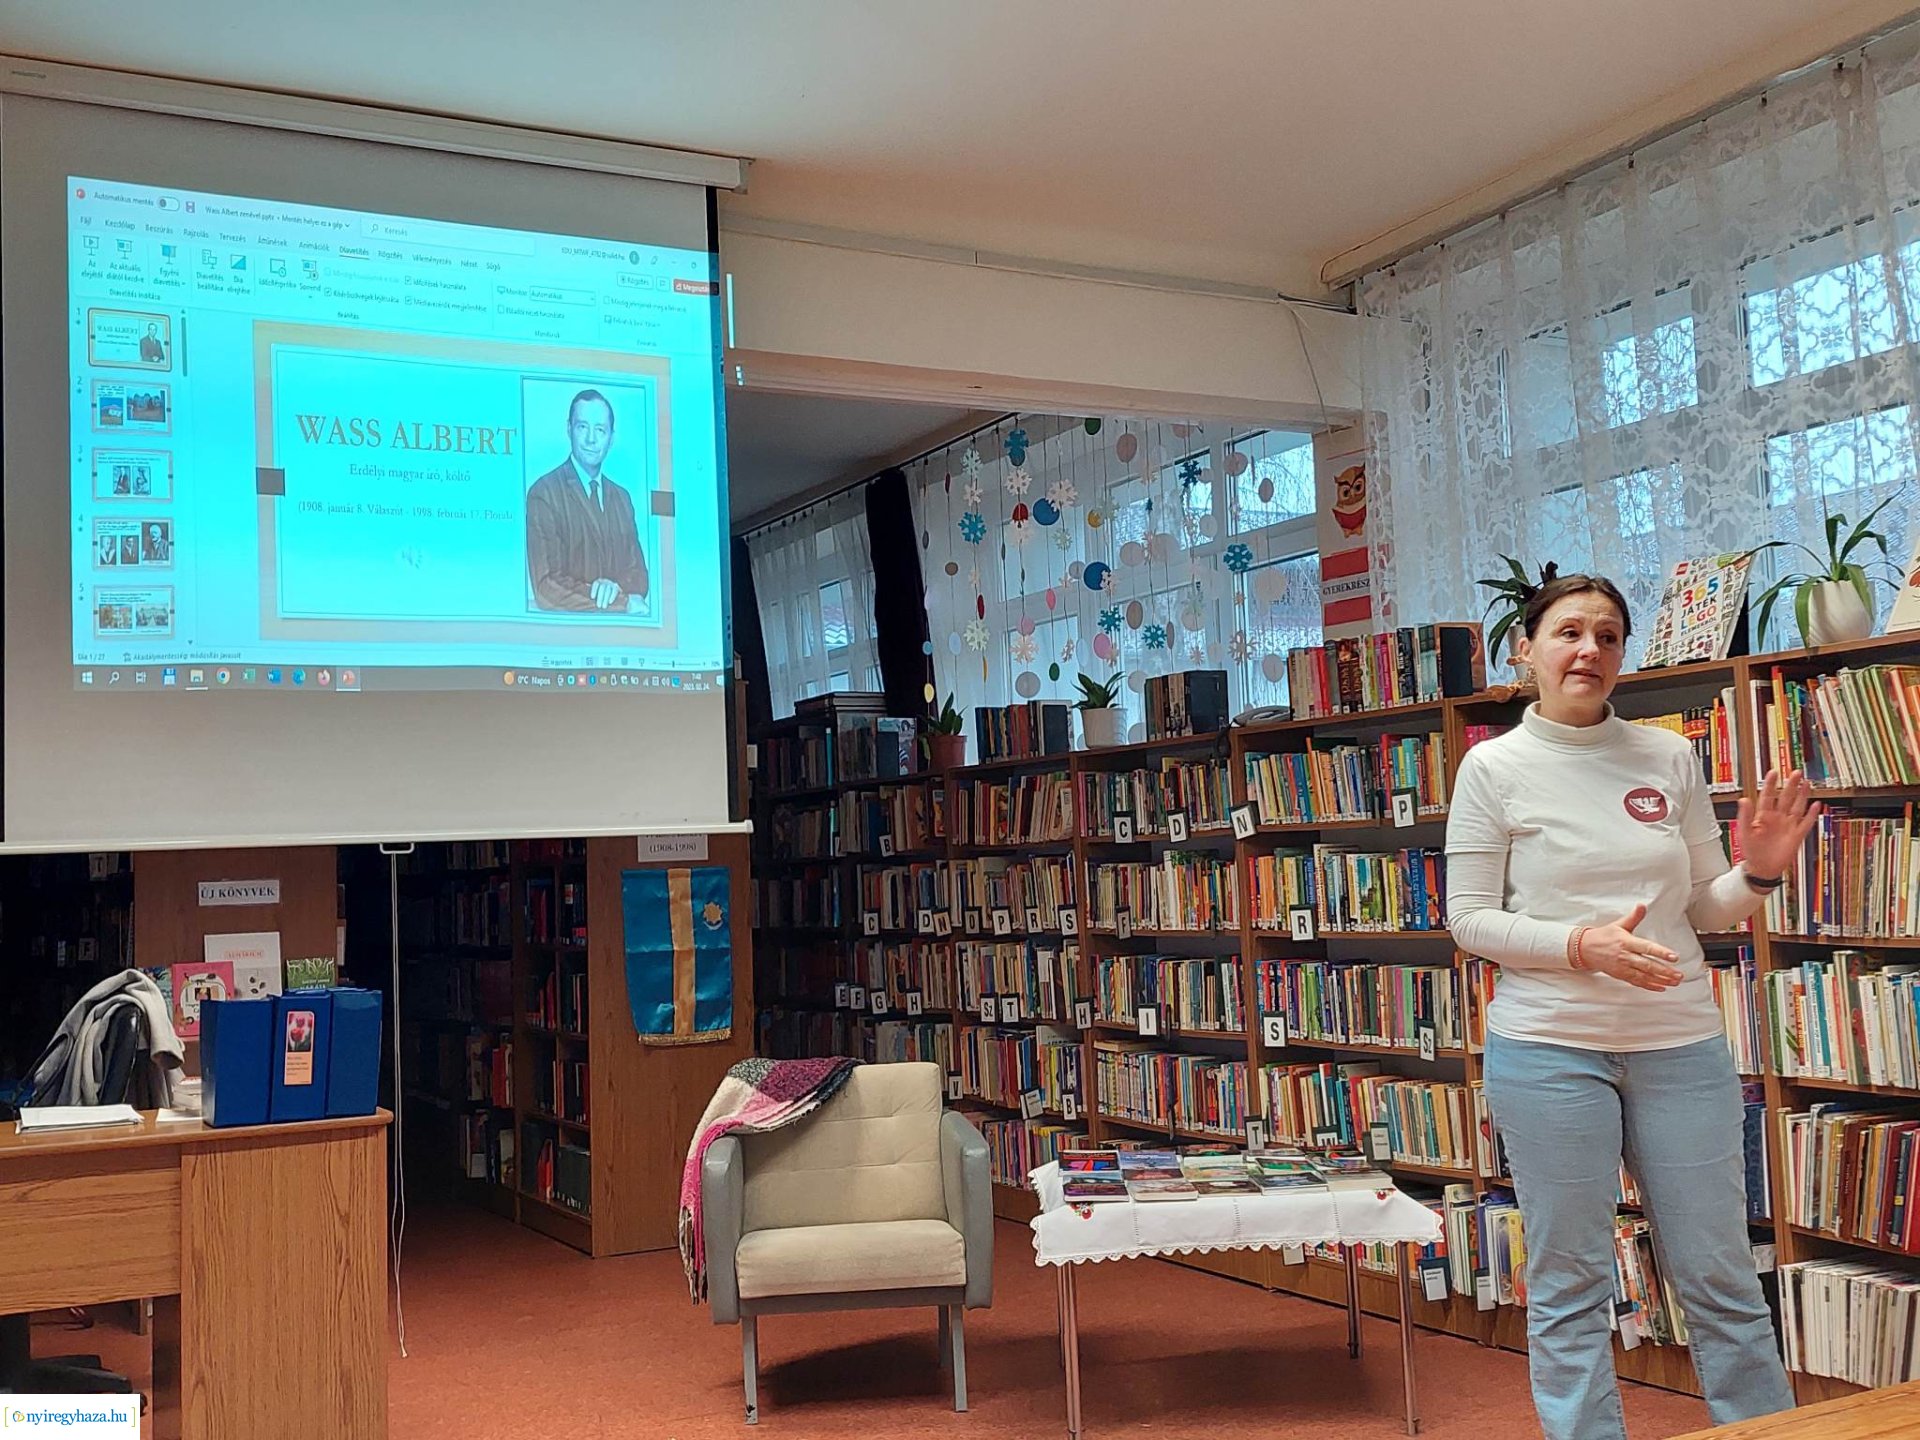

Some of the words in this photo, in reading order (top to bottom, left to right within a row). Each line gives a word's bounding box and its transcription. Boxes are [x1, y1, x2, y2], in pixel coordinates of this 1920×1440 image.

[296, 414, 382, 448] WASS
[390, 421, 518, 456] ALBERT
[350, 463, 386, 478] Erdélyi
[388, 468, 424, 482] magyar
[327, 502, 355, 516] január
[1681, 576, 1719, 608] 365
[1680, 605, 1717, 630] LEGO
[1399, 800, 1408, 815] P
[1119, 820, 1128, 838] C
[1174, 819, 1182, 836] D
[1236, 814, 1248, 834] N
[884, 838, 890, 851] B
[201, 887, 215, 900] ÚJ
[218, 886, 276, 898] KÖNYVEK
[868, 916, 875, 930] C
[922, 914, 930, 928] D
[938, 916, 948, 932] N
[998, 916, 1005, 930] P
[1030, 913, 1039, 928] R
[1066, 914, 1074, 930] S
[1121, 916, 1128, 932] F
[1298, 915, 1307, 934] R
[855, 992, 862, 1005] F
[875, 995, 884, 1009] G
[910, 996, 918, 1010] H
[1006, 1001, 1014, 1016] T
[1079, 1008, 1087, 1024] H
[1146, 1012, 1150, 1030] I
[1270, 1021, 1280, 1041] S
[953, 1080, 959, 1096] V
[1066, 1095, 1072, 1114] B
[1252, 1126, 1259, 1145] T
